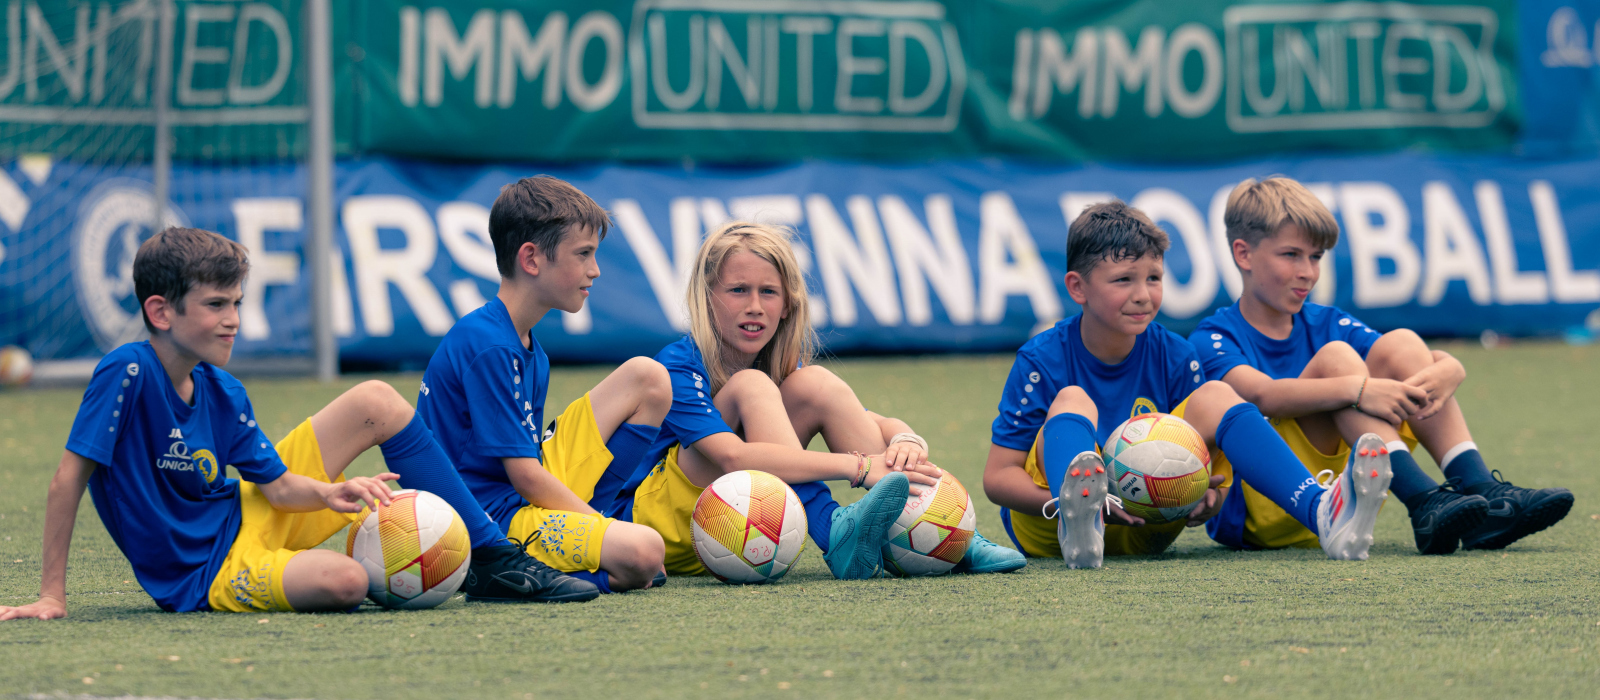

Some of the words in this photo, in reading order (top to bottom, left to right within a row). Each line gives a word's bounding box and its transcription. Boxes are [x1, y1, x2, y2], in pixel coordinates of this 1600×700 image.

[400, 7, 624, 112] IMMO
[648, 13, 947, 114] UNITED
[1009, 22, 1225, 121] IMMO
[1241, 21, 1486, 116] UNITED
[610, 193, 1063, 334] VNNA
[156, 459, 195, 472] UNIQA
